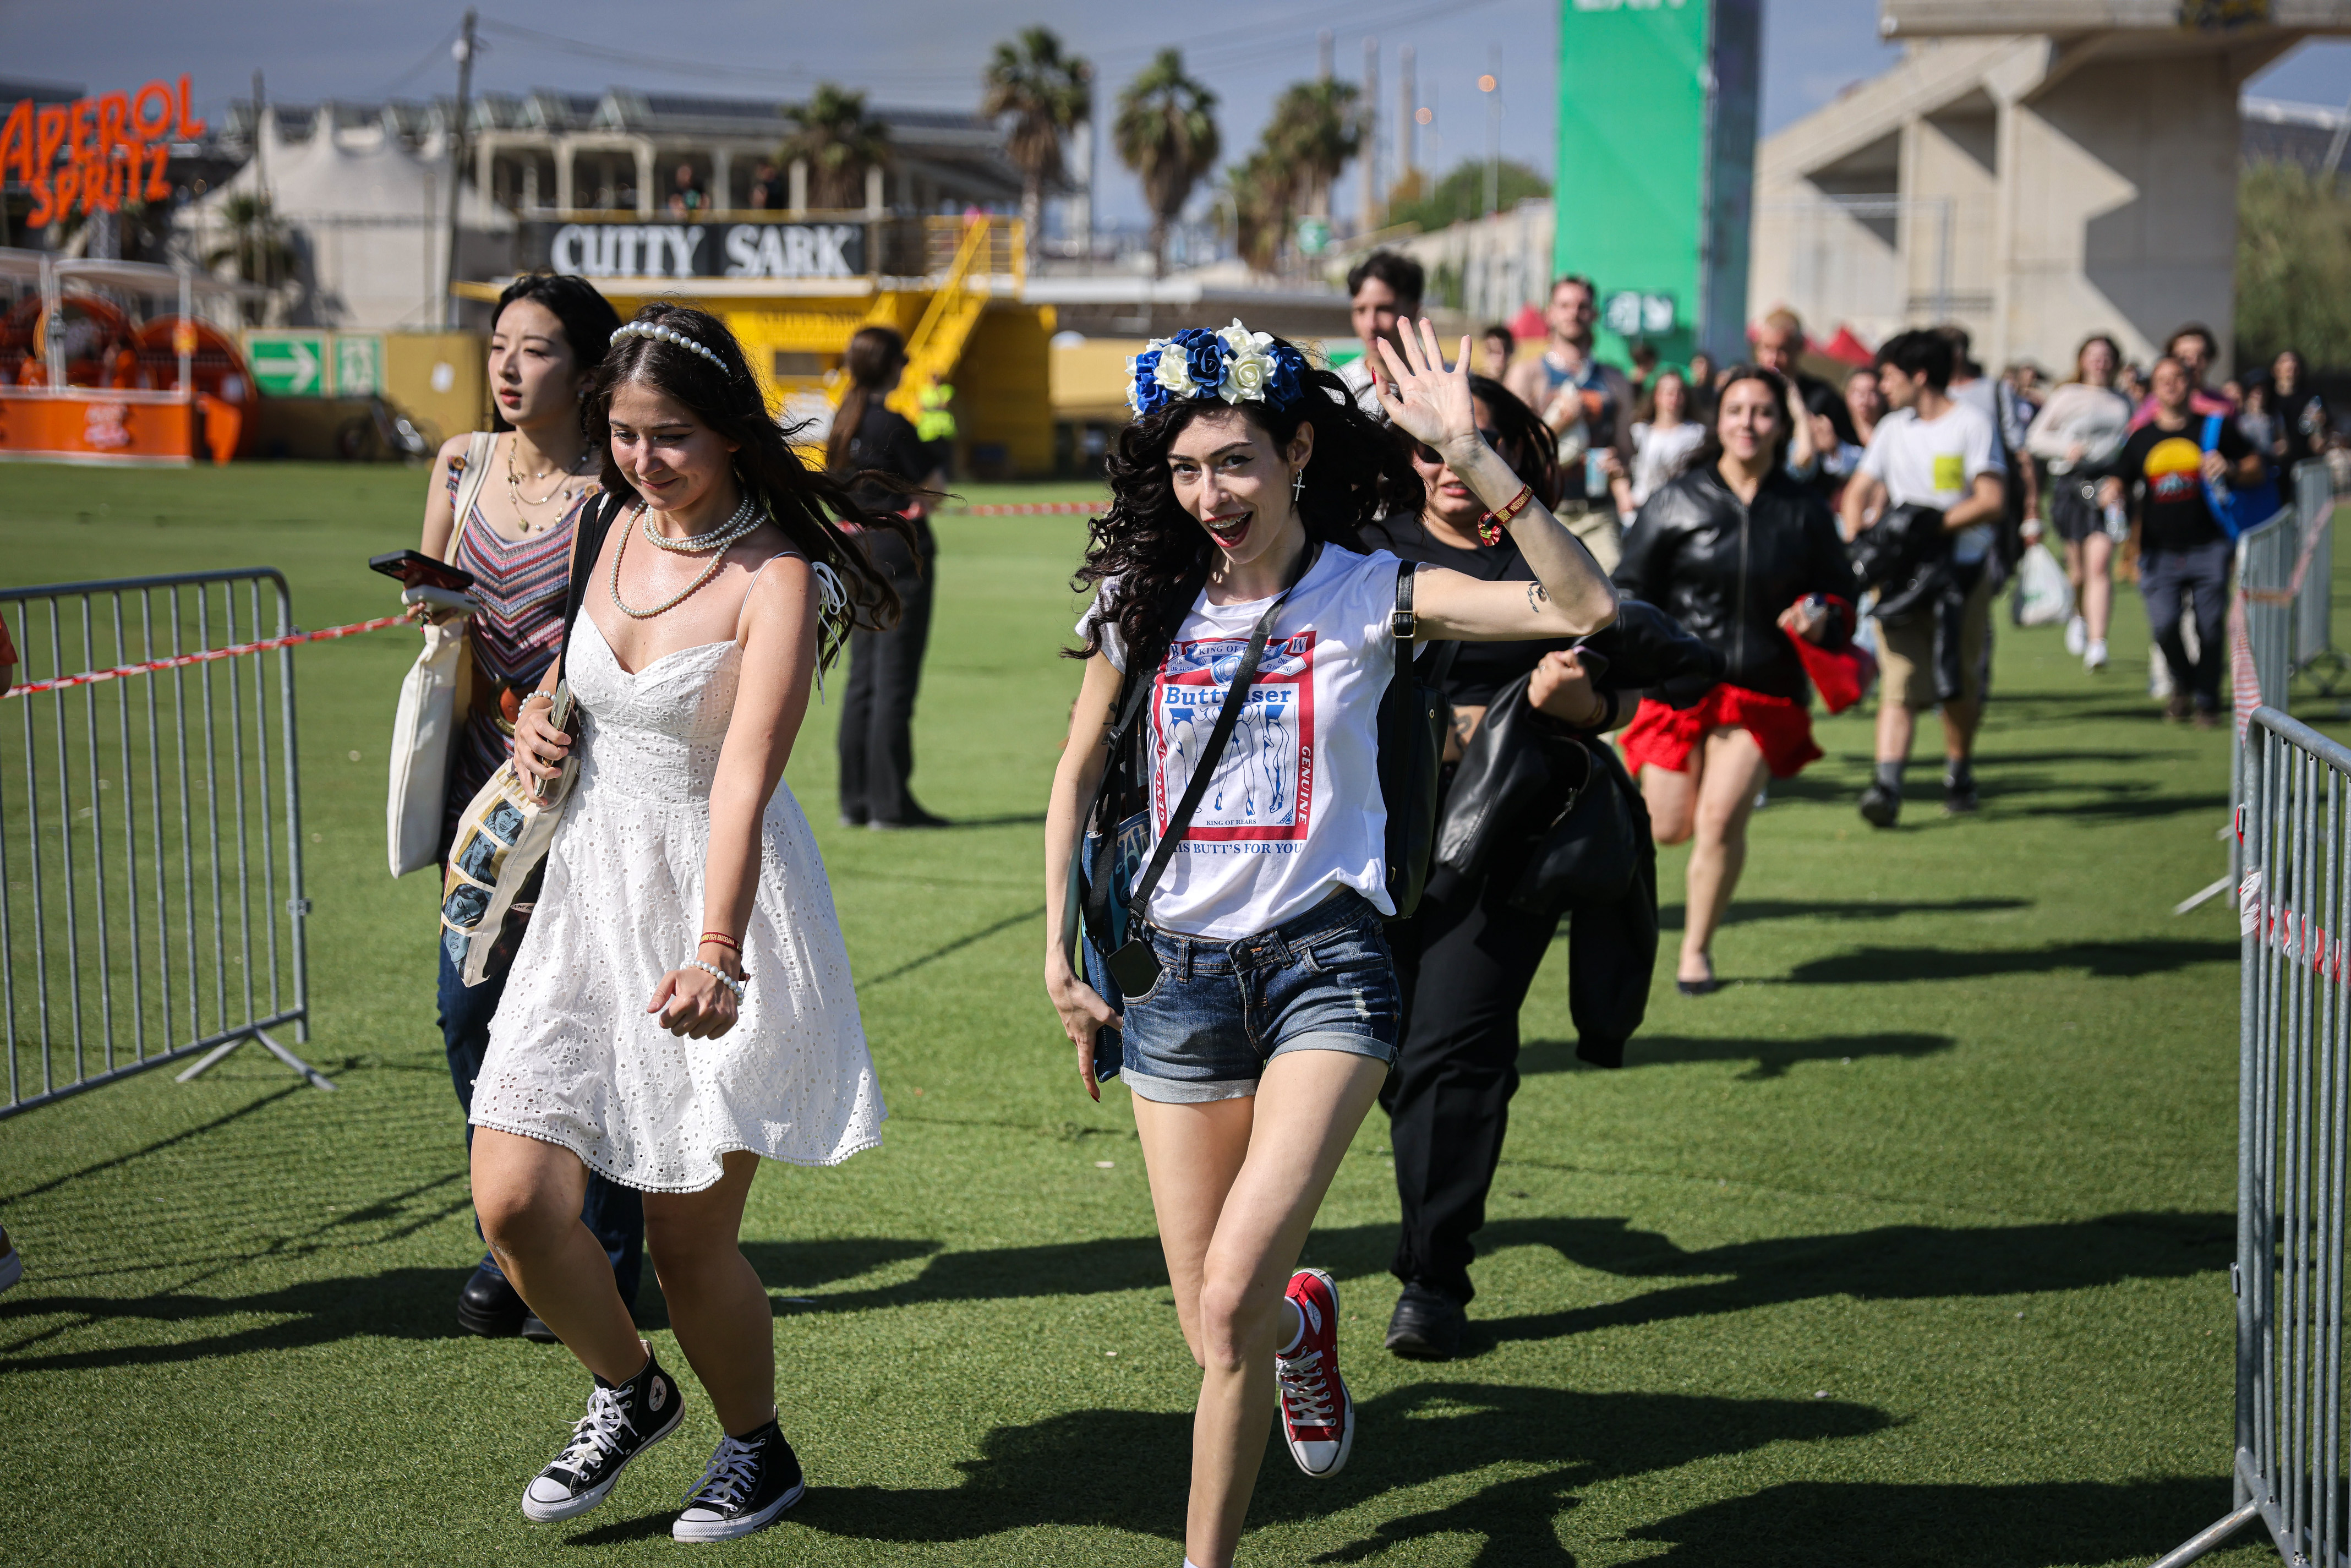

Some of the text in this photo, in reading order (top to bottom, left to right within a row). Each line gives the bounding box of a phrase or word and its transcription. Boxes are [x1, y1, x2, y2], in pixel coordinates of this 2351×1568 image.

[0, 72, 207, 190] APEROL
[26, 141, 172, 229] SPRITZ
[551, 223, 855, 276] CUTTY SARK
[1510, 494, 1528, 512] BARCELONA
[1199, 646, 1223, 655] KING
[1293, 638, 1306, 652] W
[1299, 746, 1311, 824] GENUINE
[1193, 843, 1241, 854] BUTT'S
[1244, 843, 1271, 853] FOR
[1275, 843, 1303, 853] YOU
